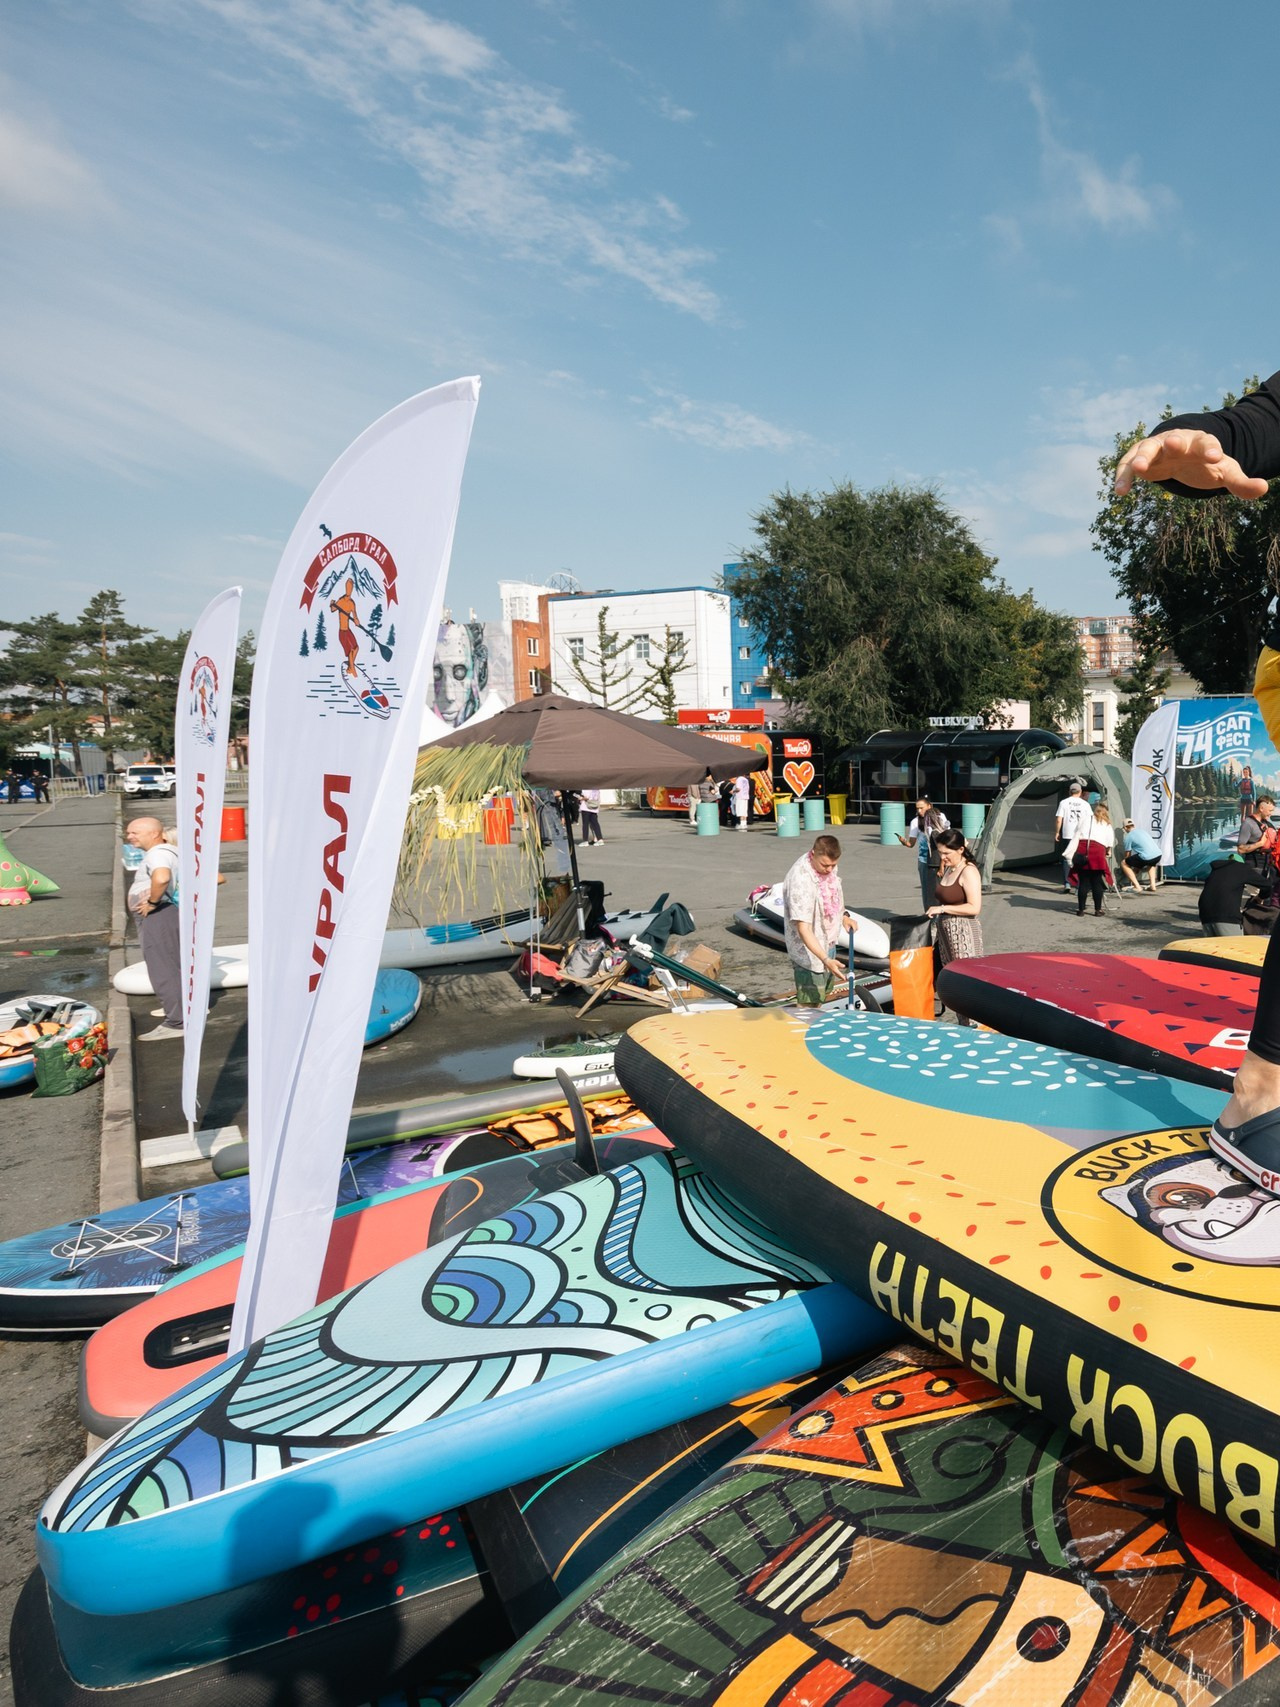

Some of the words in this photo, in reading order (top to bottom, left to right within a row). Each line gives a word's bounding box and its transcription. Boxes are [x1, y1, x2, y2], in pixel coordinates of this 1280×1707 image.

[1177, 727, 1213, 765] 74
[1216, 732, 1250, 750] ФЕСТ
[1217, 716, 1250, 735] САП
[1074, 1137, 1161, 1184] BUCK
[868, 1241, 1042, 1410] TEETH
[1066, 1353, 1279, 1547] BUCK
